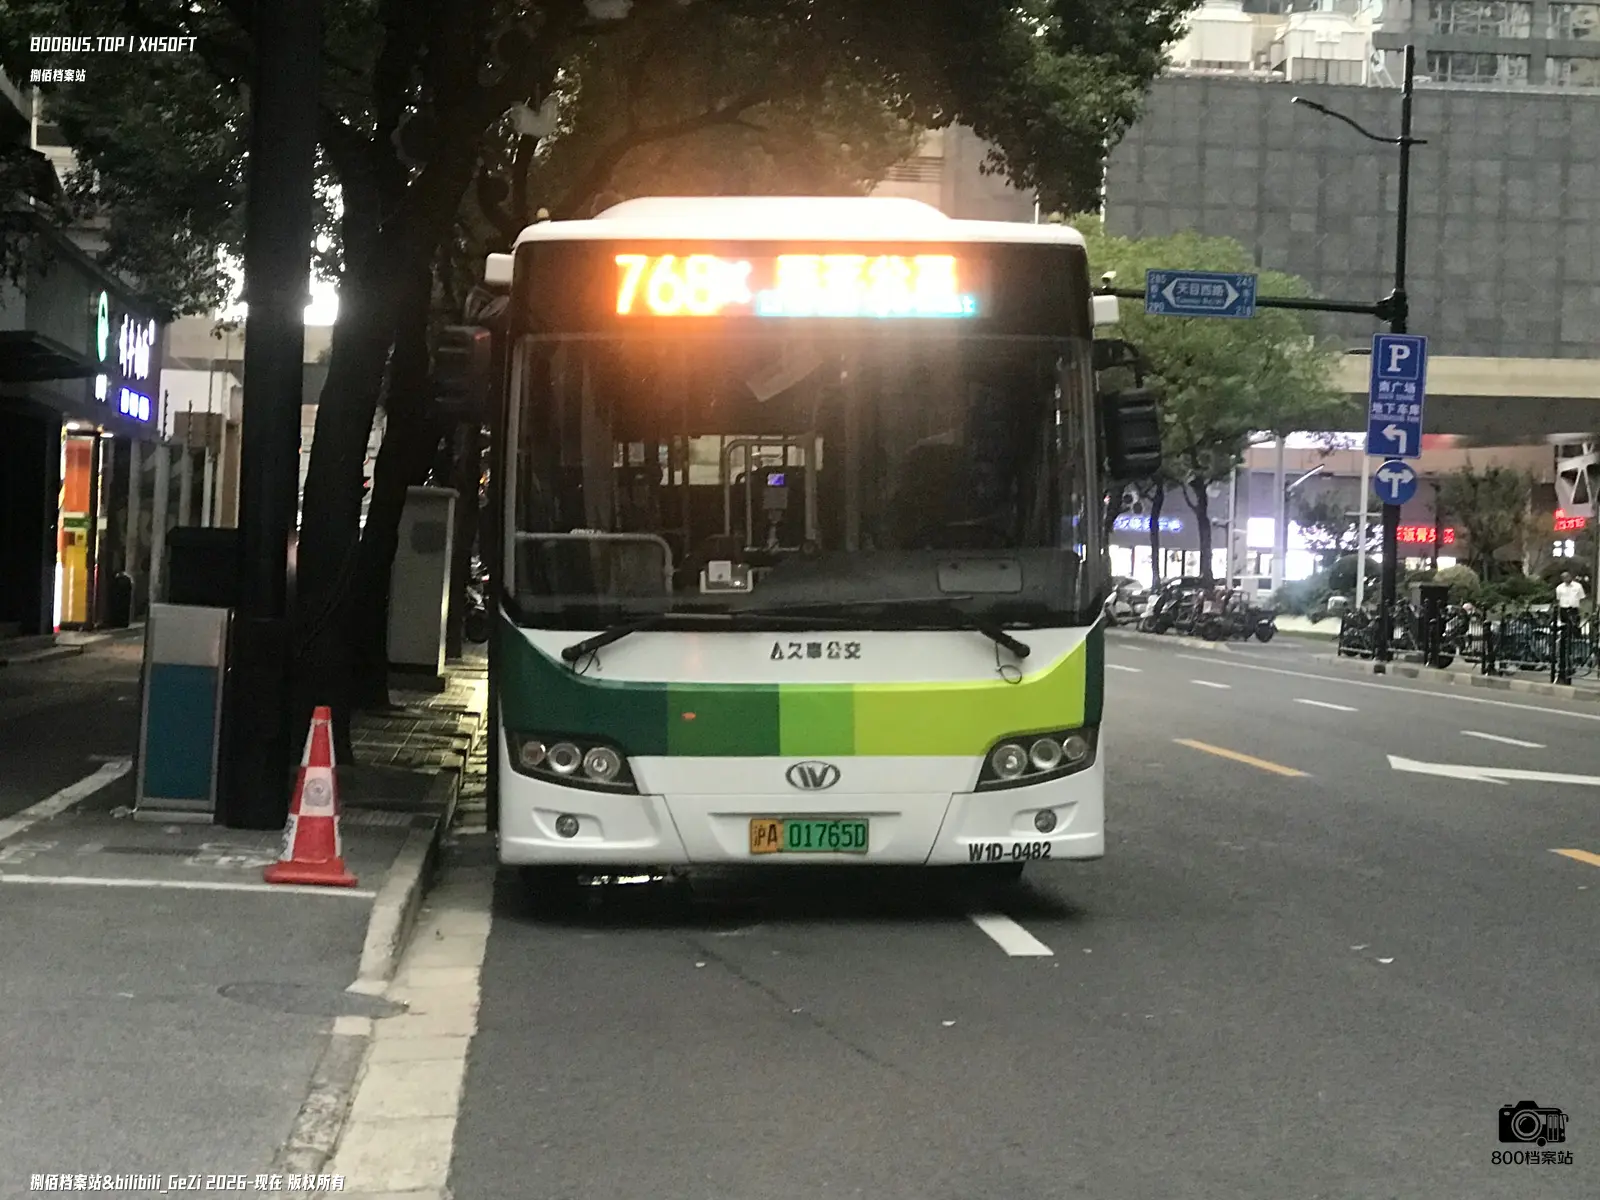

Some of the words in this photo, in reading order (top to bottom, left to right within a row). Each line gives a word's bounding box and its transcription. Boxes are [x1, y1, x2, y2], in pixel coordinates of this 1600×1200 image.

[615, 254, 752, 315] 768
[1387, 344, 1411, 372] P
[968, 841, 1052, 861] W1D-0482
